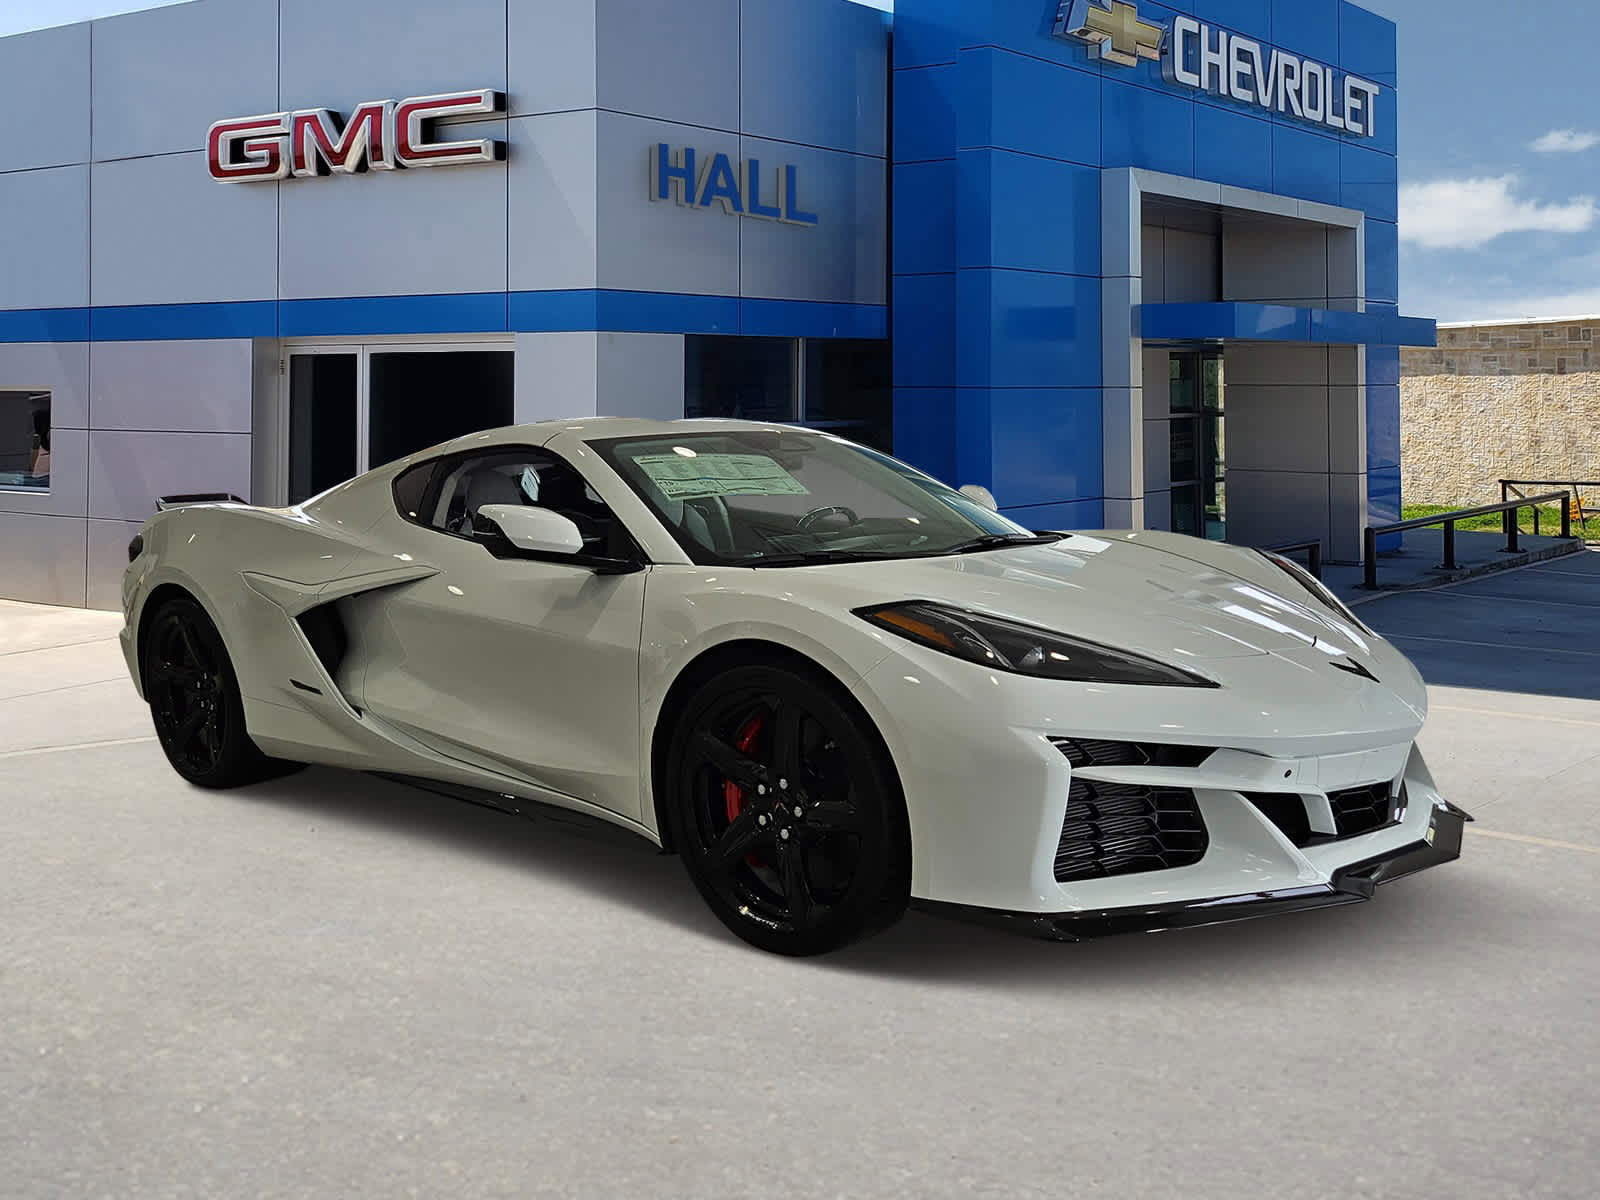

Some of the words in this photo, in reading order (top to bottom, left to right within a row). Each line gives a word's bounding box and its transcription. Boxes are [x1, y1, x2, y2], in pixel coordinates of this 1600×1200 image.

[1174, 15, 1379, 137] CHEVROLET
[207, 88, 506, 184] GMC
[654, 143, 818, 225] HALL
